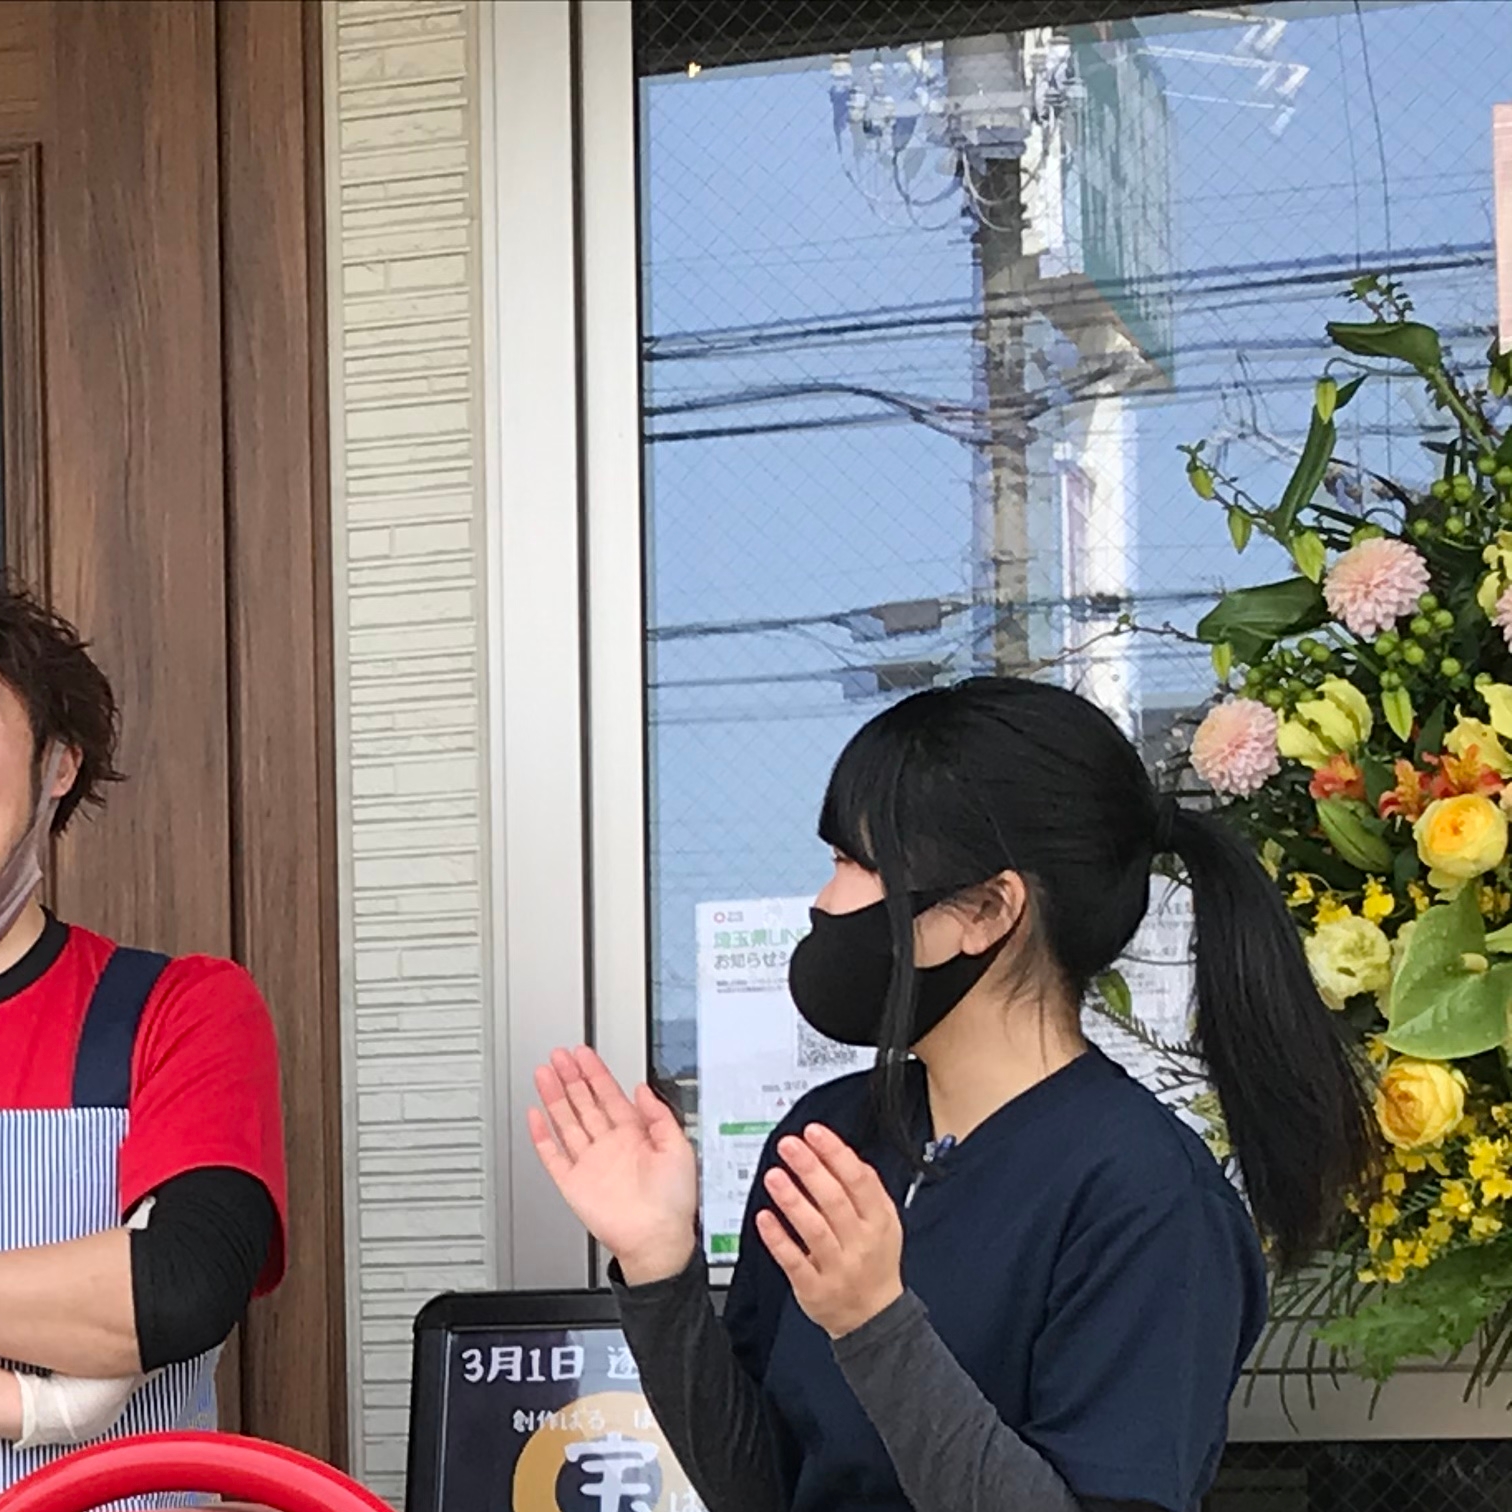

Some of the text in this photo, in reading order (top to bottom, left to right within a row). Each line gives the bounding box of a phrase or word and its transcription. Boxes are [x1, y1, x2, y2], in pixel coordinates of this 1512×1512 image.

[461, 1346, 585, 1383] 3月1日
[512, 1409, 606, 1433] 創作ばる
